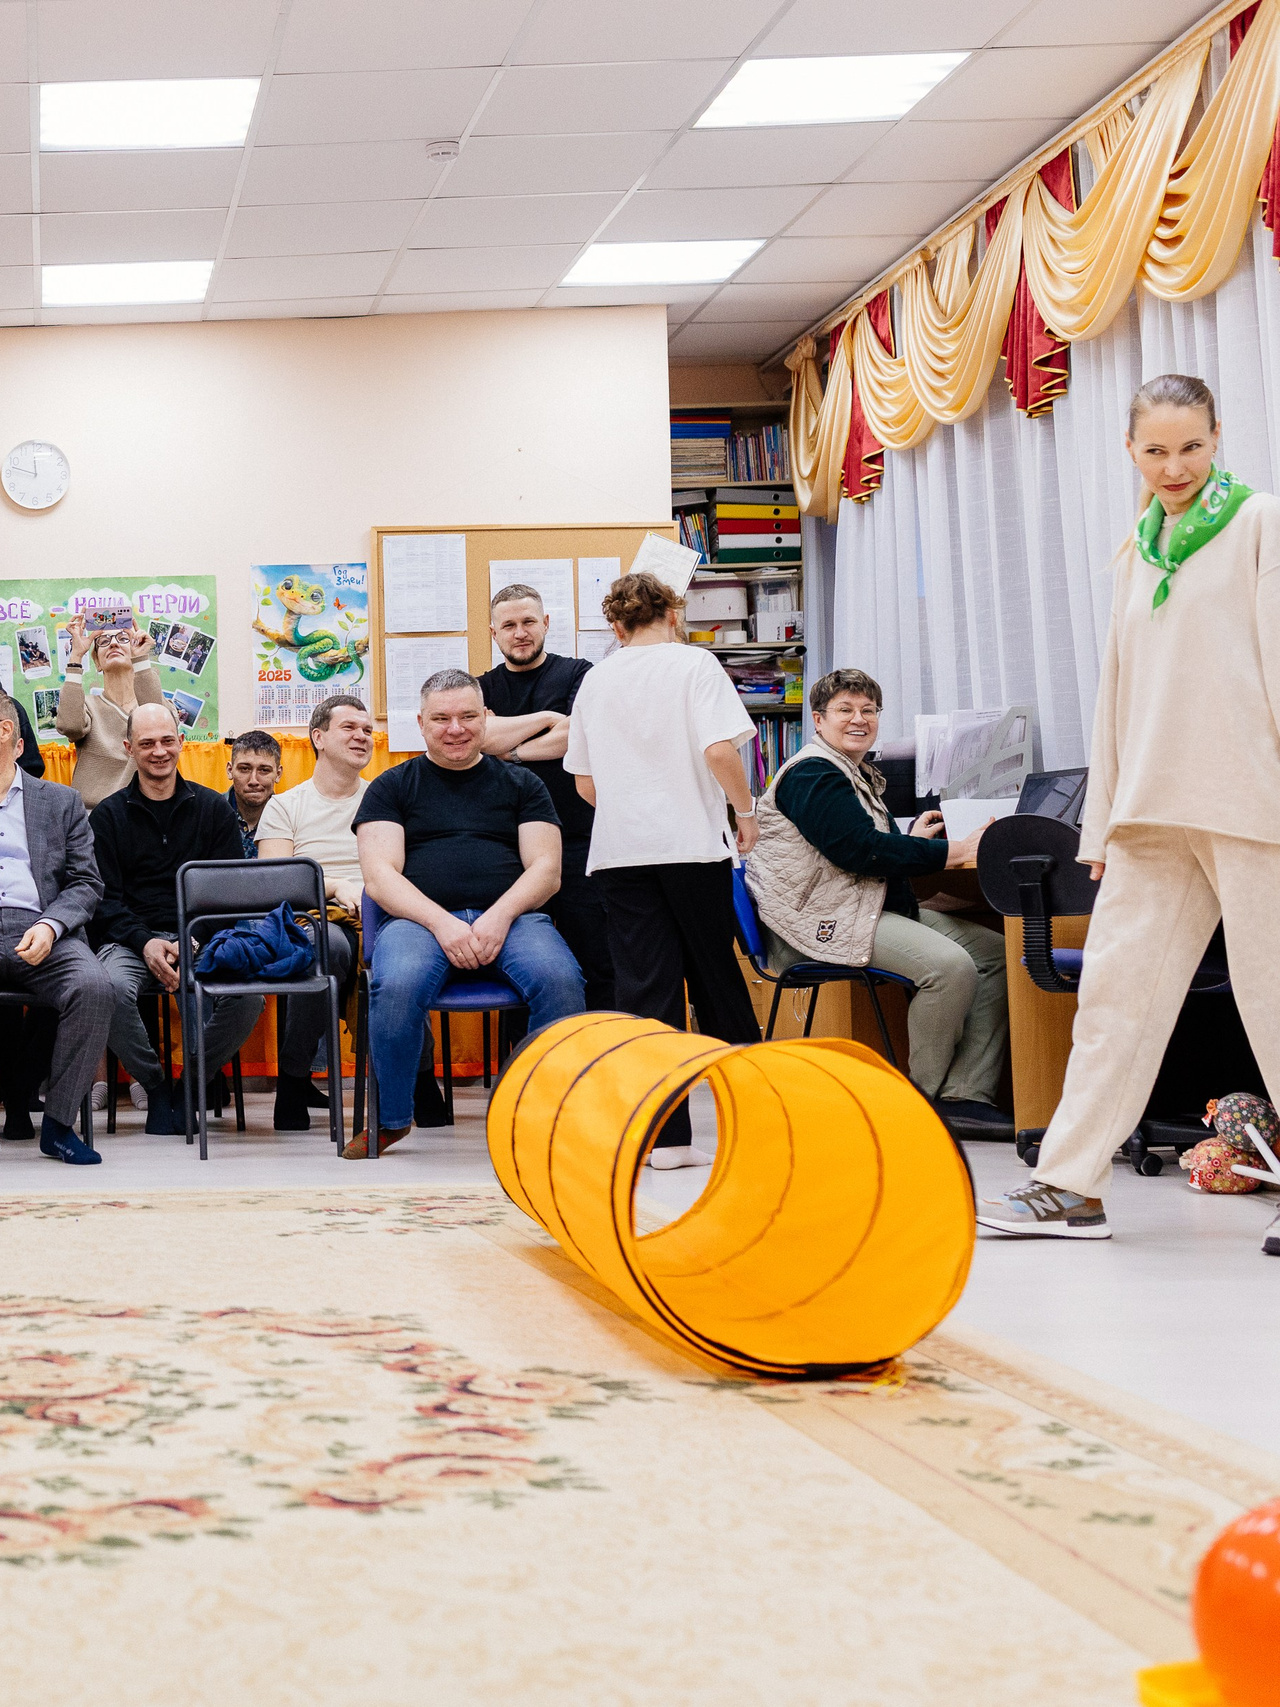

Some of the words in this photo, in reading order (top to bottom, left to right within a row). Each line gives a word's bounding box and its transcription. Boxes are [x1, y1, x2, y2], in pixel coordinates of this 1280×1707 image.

[20, 446, 27, 456] 11
[32, 443, 42, 453] 12
[10, 457, 19, 466] 10
[57, 457, 64, 466] 2
[5, 469, 11, 478] 9
[60, 470, 67, 480] 3
[9, 483, 15, 492] 8
[56, 483, 63, 493] 4
[19, 492, 25, 501] 7
[32, 497, 38, 506] 6
[46, 492, 53, 502] 5
[333, 565, 347, 579] Год
[336, 575, 365, 586] Змеи!
[138, 594, 200, 614] ГЕРОИ
[258, 669, 292, 682] 2025
[1029, 1194, 1059, 1217] N
